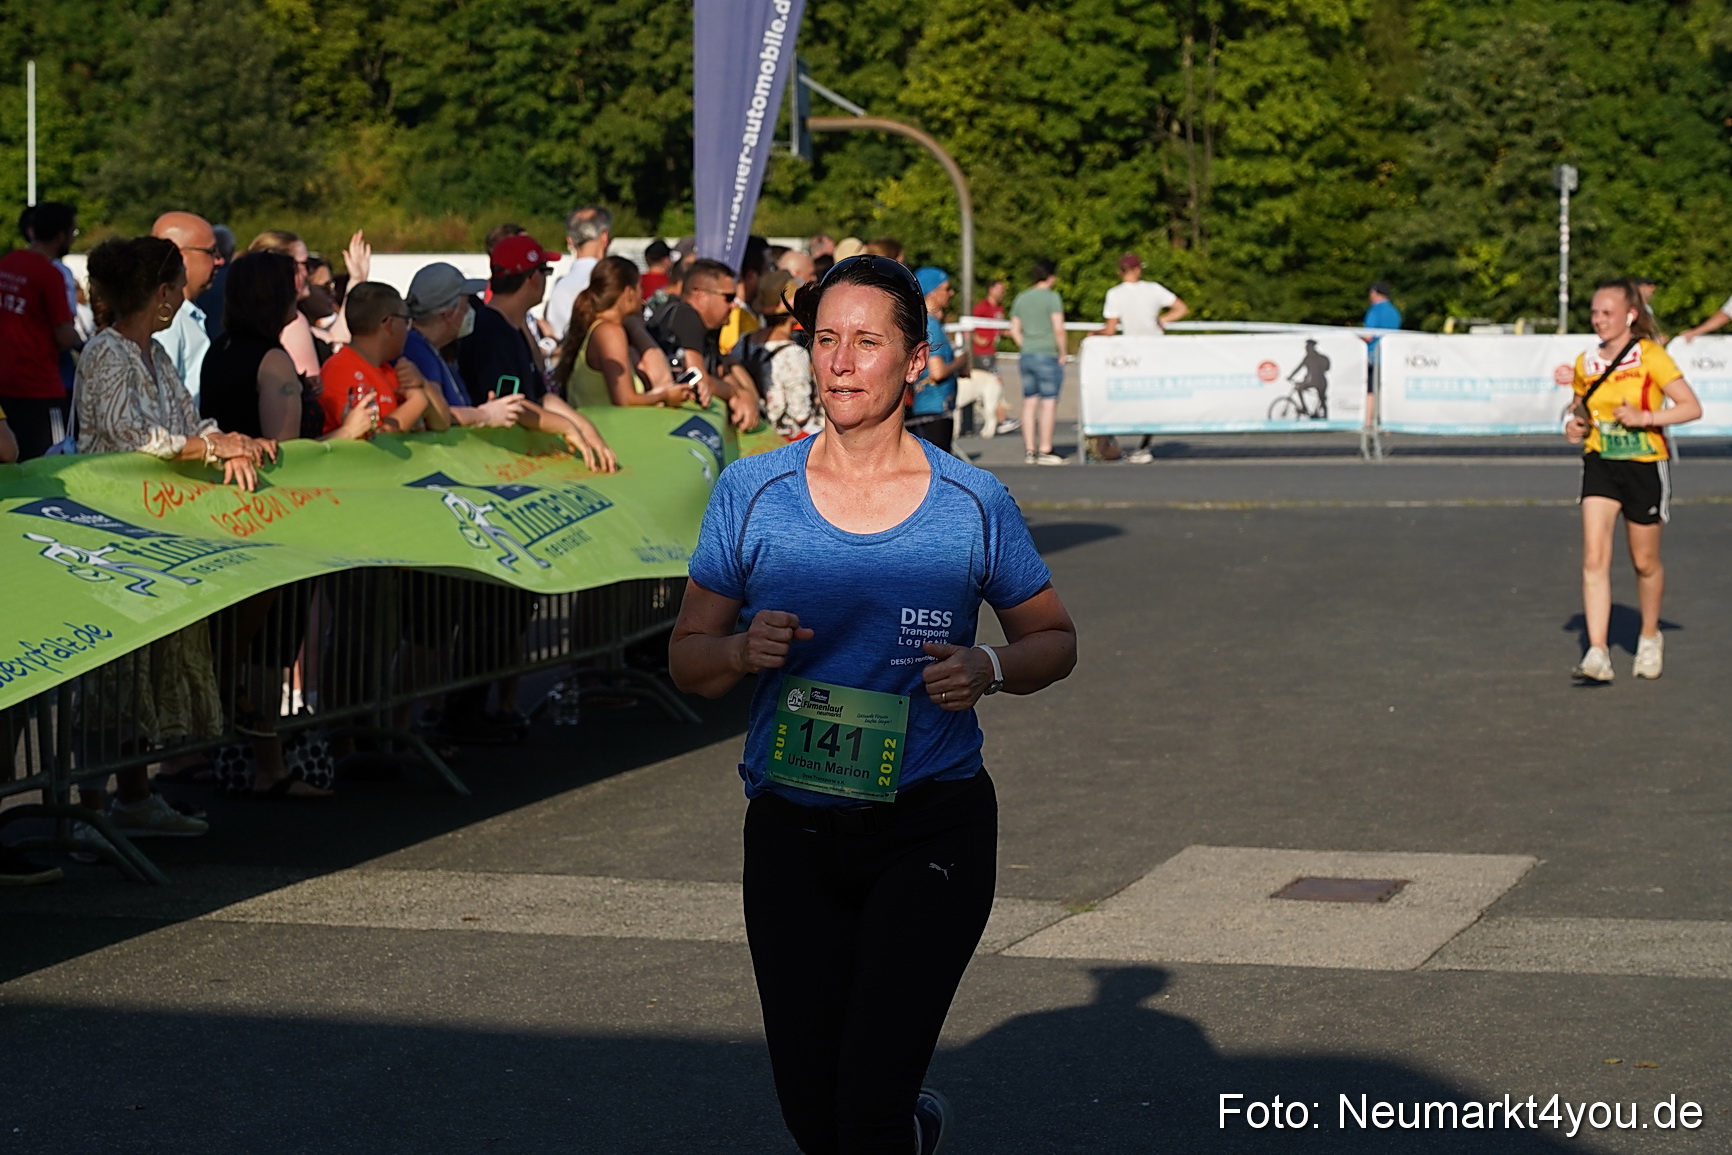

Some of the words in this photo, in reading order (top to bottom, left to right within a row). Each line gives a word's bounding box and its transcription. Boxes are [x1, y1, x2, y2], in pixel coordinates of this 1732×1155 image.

[900, 607, 953, 628] DESS
[900, 626, 950, 639] Transporte
[803, 701, 844, 713] Firmenlauf
[774, 724, 788, 760] RUN
[799, 718, 863, 762] 141
[787, 754, 820, 770] Urban
[825, 762, 869, 778] Marion
[878, 738, 897, 787] 2022
